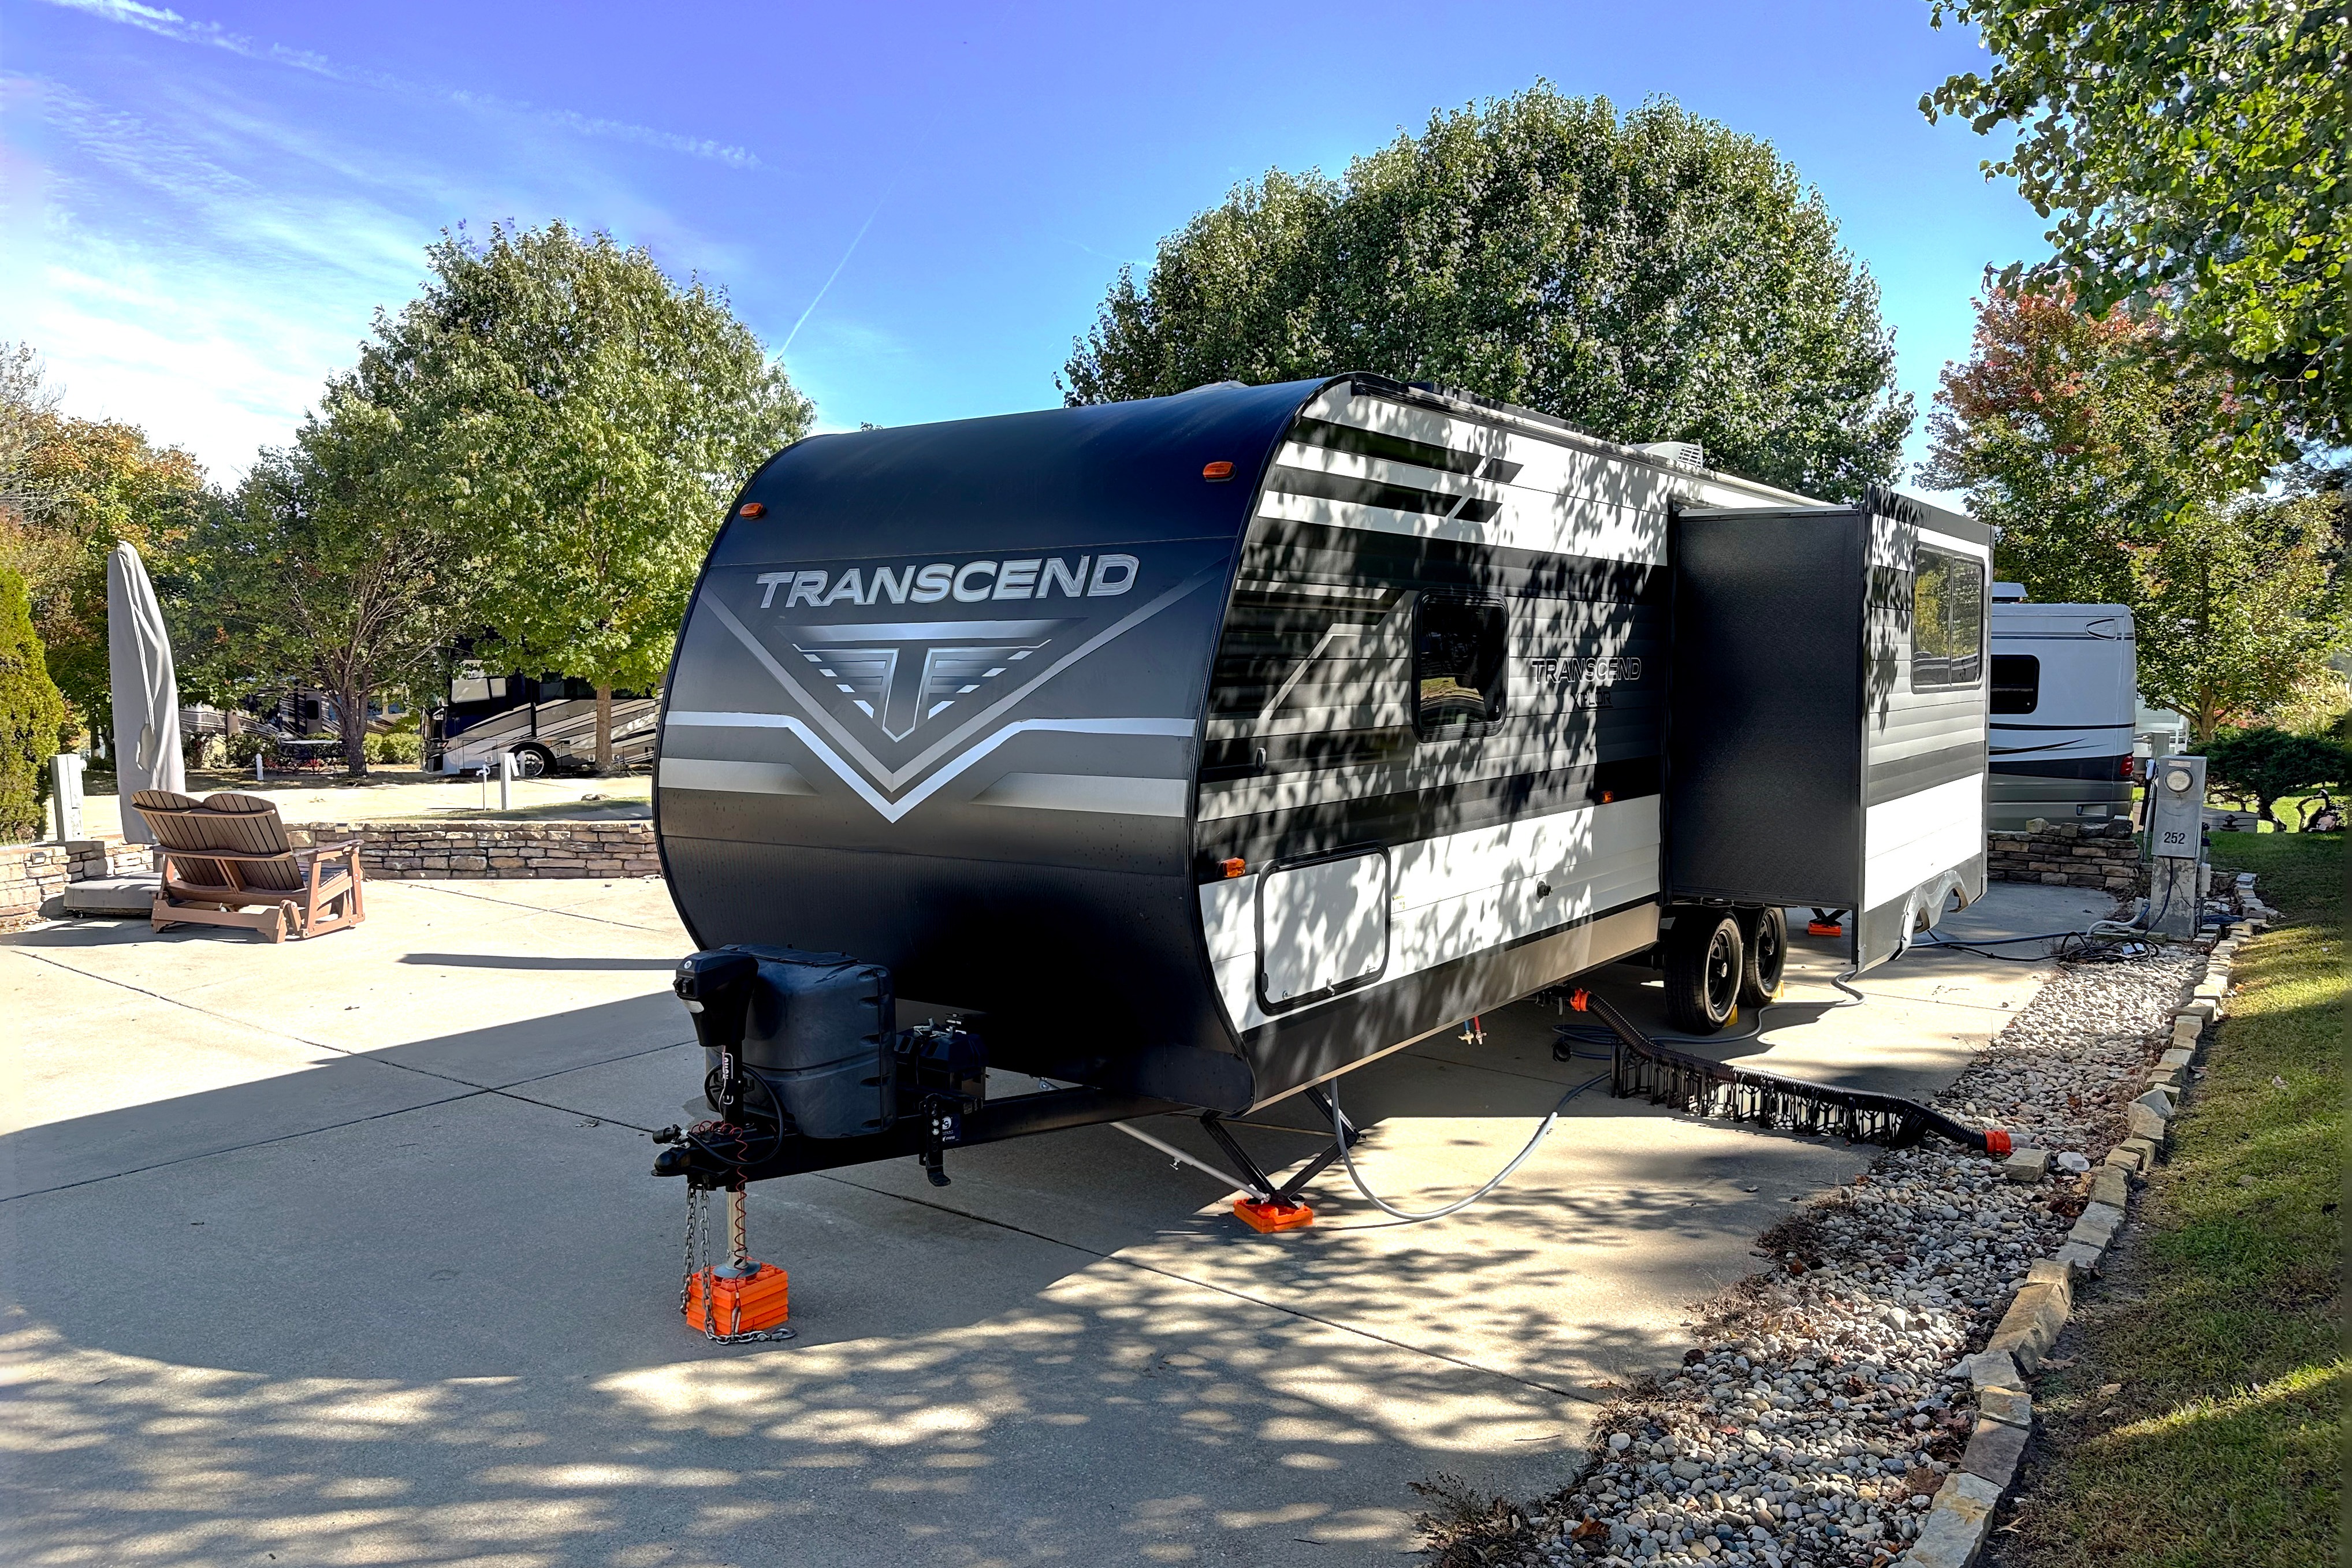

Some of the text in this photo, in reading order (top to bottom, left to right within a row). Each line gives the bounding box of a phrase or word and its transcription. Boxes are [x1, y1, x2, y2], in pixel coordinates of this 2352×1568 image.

[756, 553, 1140, 609] TRANSCEND
[1532, 657, 1642, 684] TRANSCEND
[2164, 832, 2185, 844] 252
